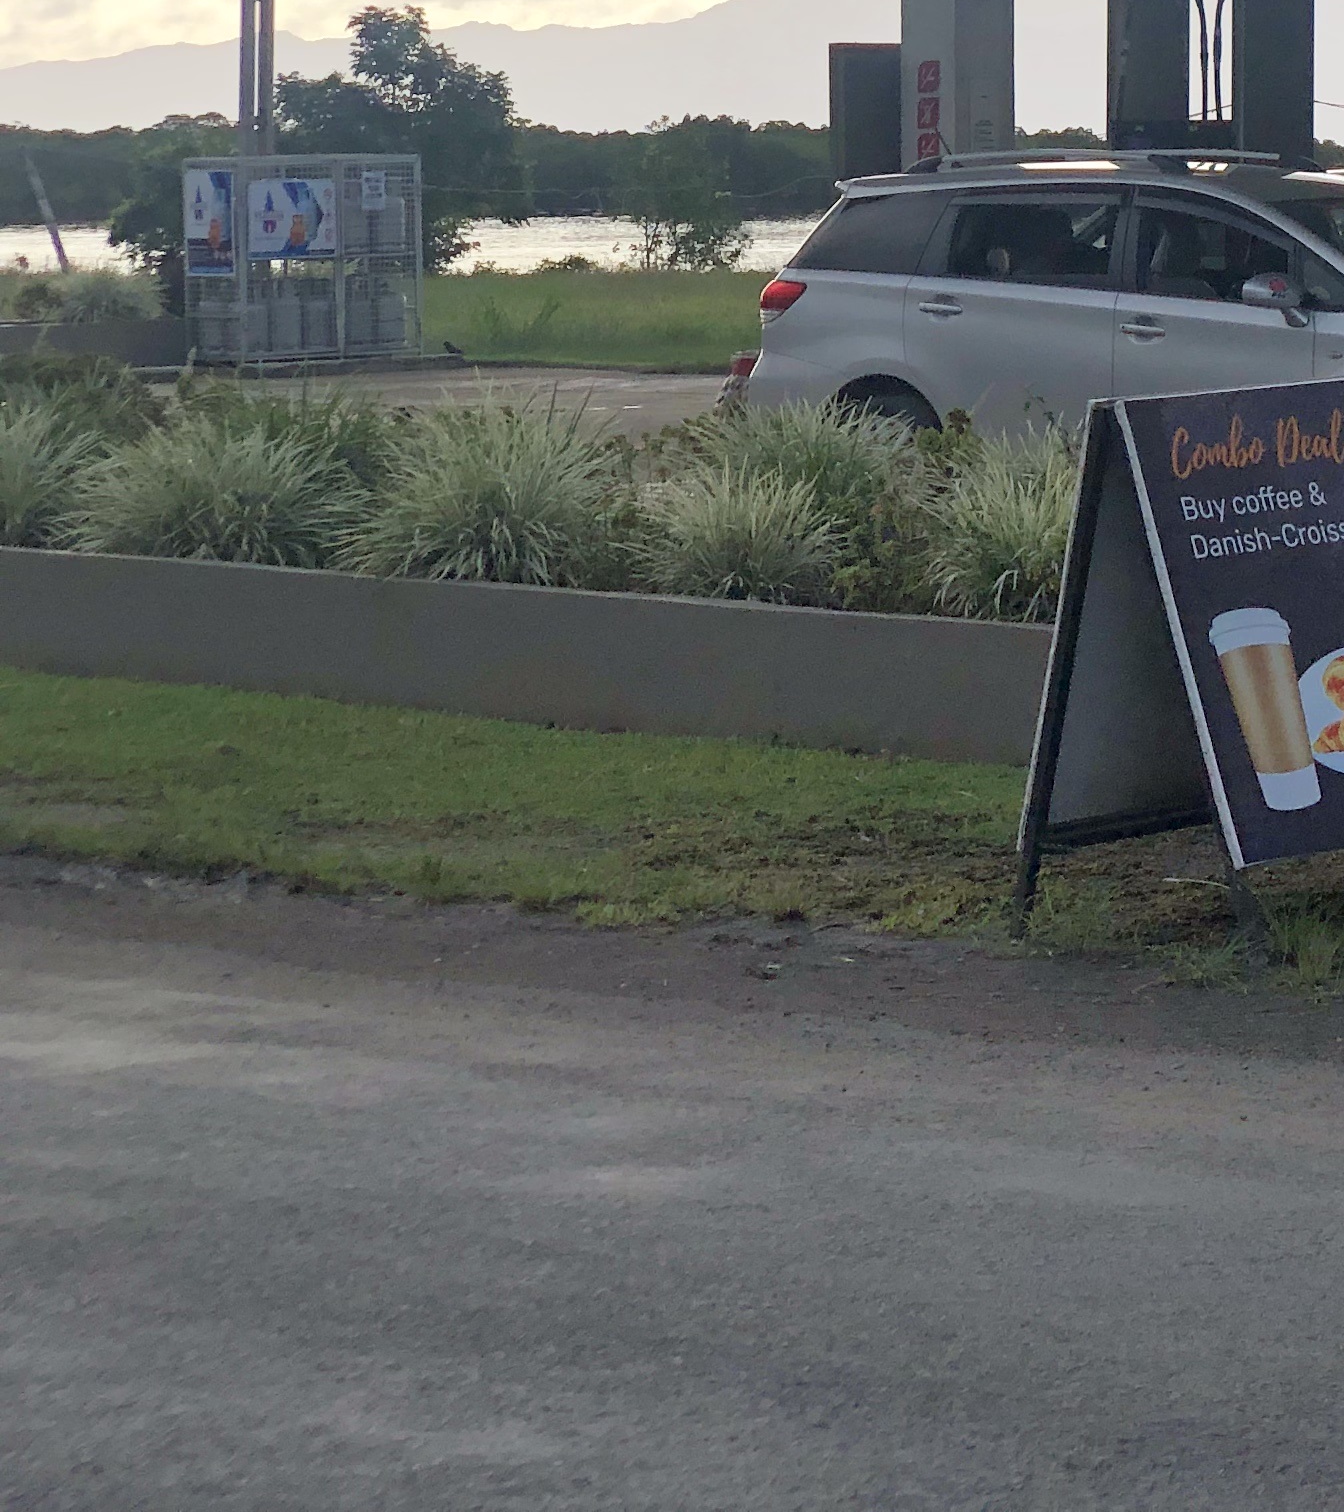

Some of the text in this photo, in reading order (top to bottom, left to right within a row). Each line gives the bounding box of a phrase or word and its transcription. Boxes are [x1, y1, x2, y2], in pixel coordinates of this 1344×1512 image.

[1170, 412, 1266, 480] Combo
[1180, 481, 1328, 523] Buy coffee &
